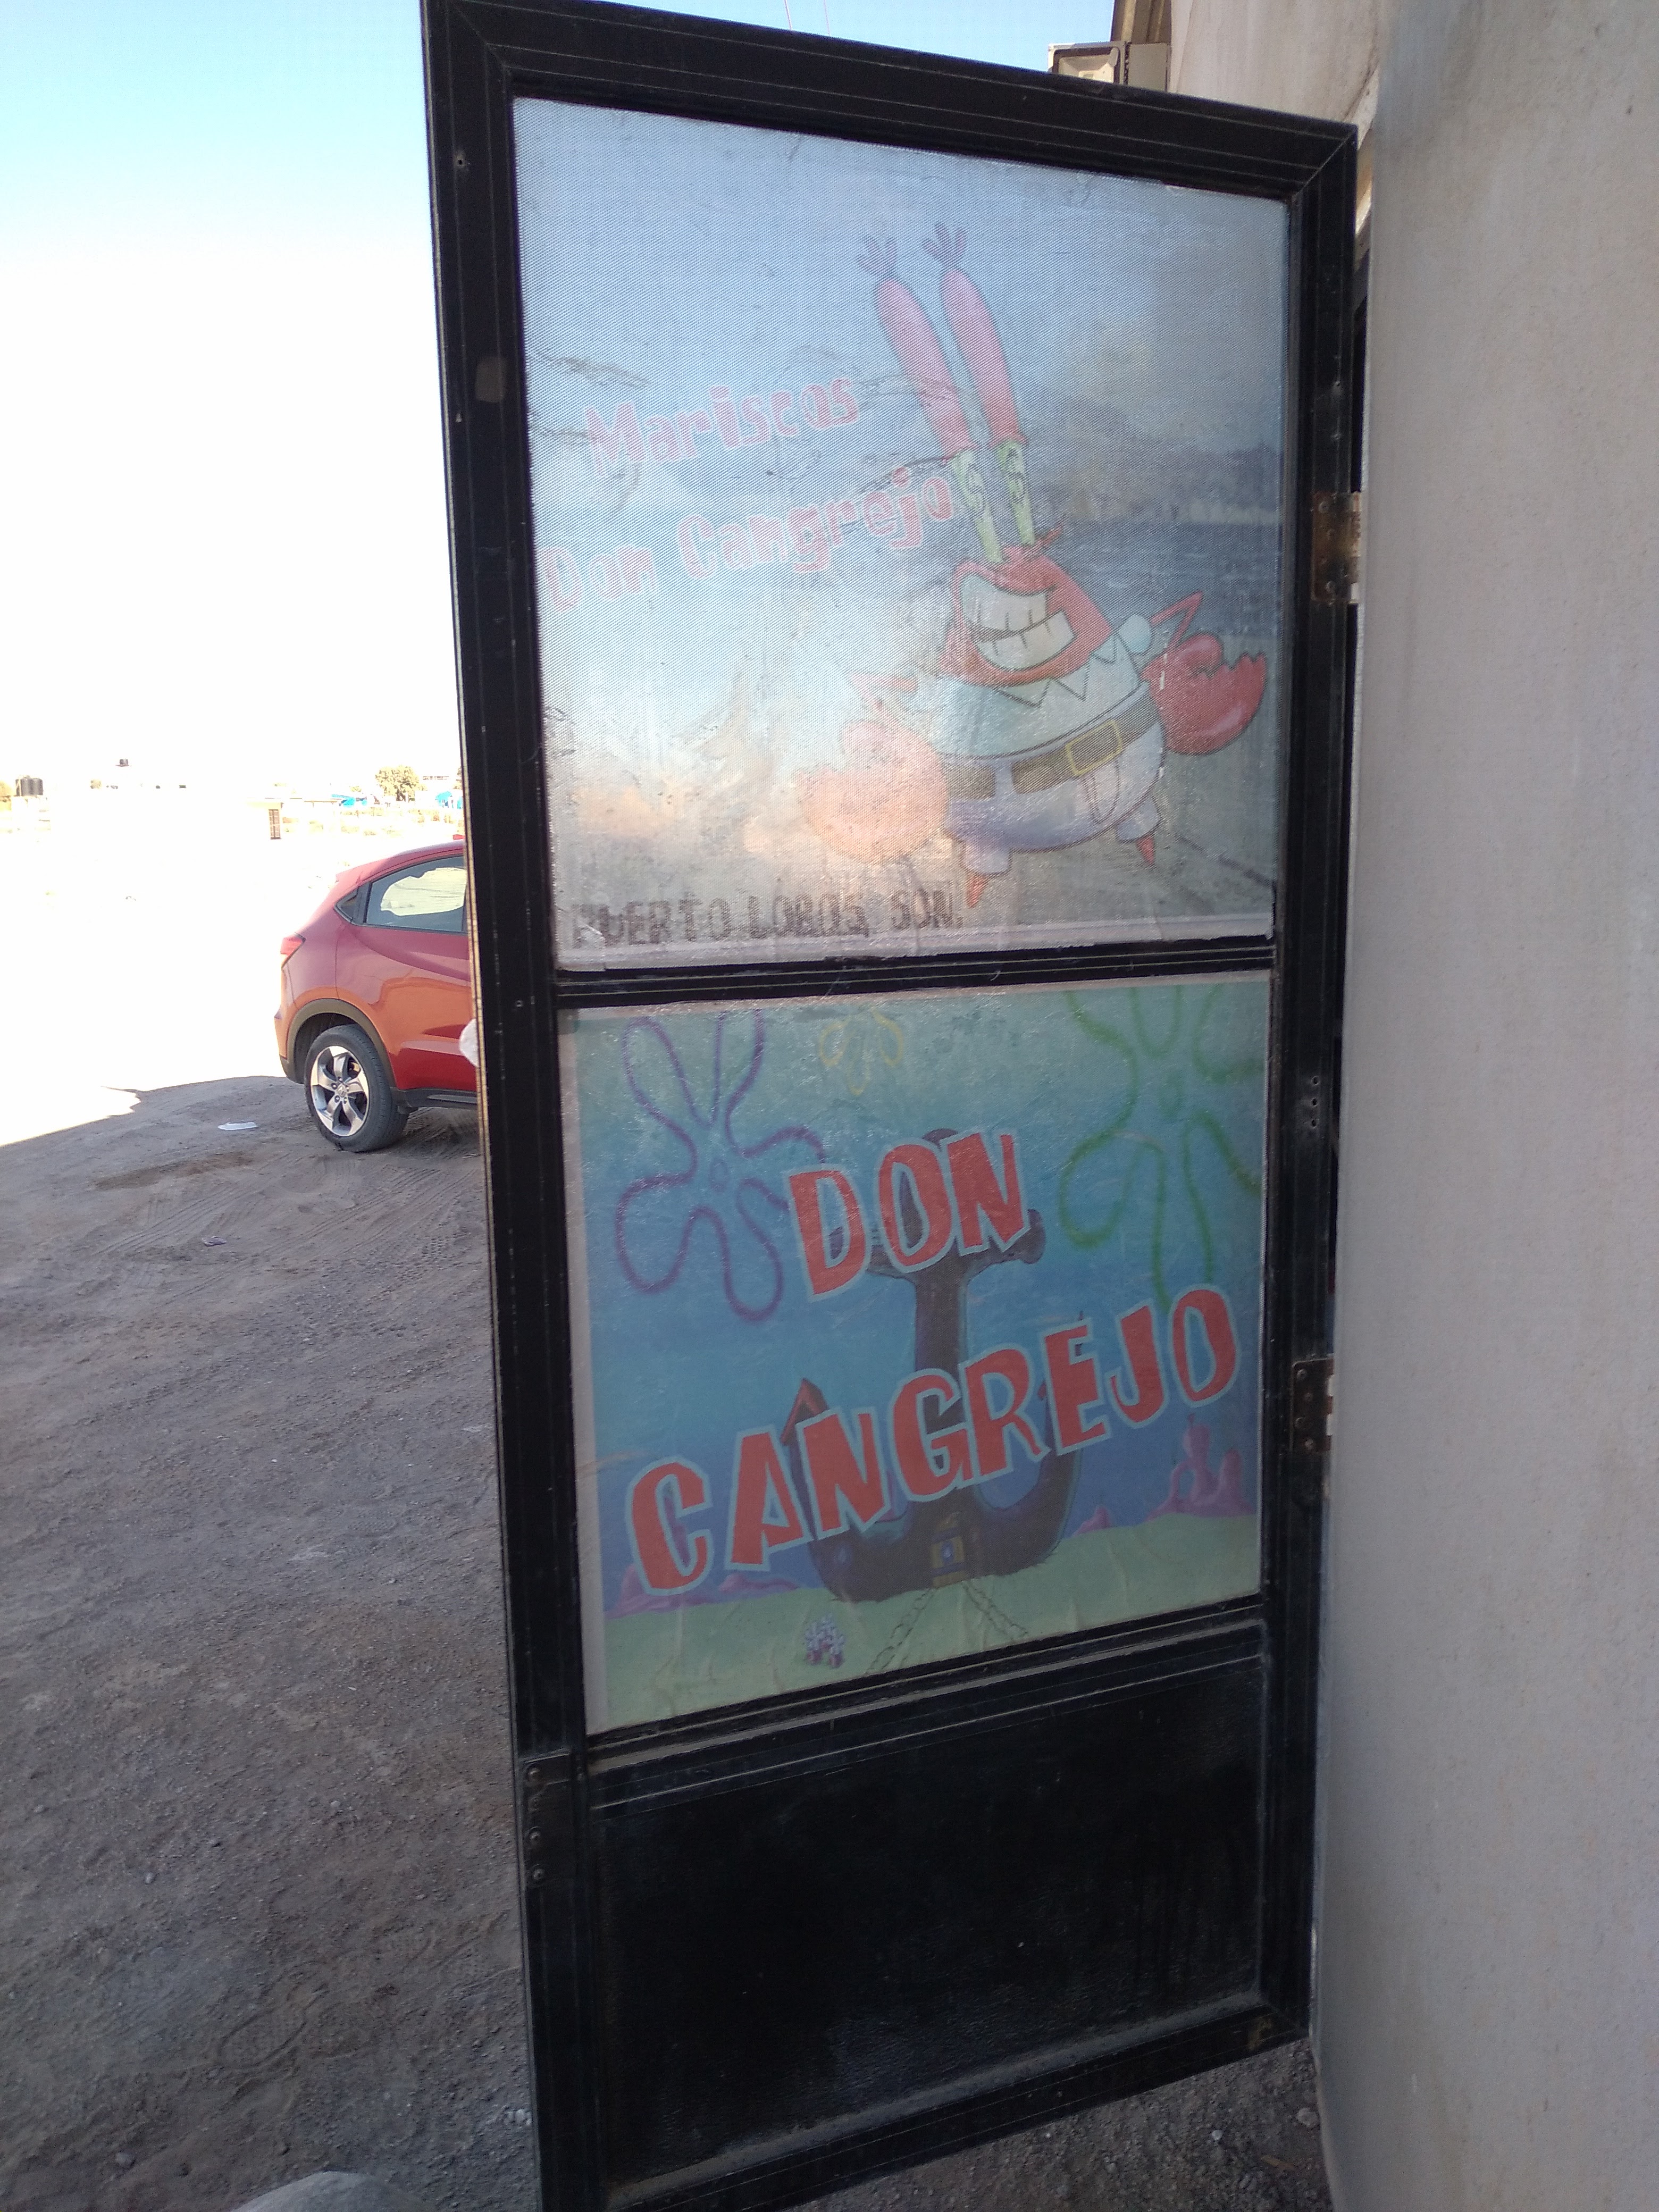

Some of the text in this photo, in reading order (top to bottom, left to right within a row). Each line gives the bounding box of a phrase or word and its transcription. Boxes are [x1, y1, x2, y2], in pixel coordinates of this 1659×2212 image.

[584, 378, 859, 475] Mariscos
[539, 466, 955, 610] Don Cangrejo
[789, 1133, 1027, 1297] DON
[629, 1287, 1238, 1594] CANGREJO
